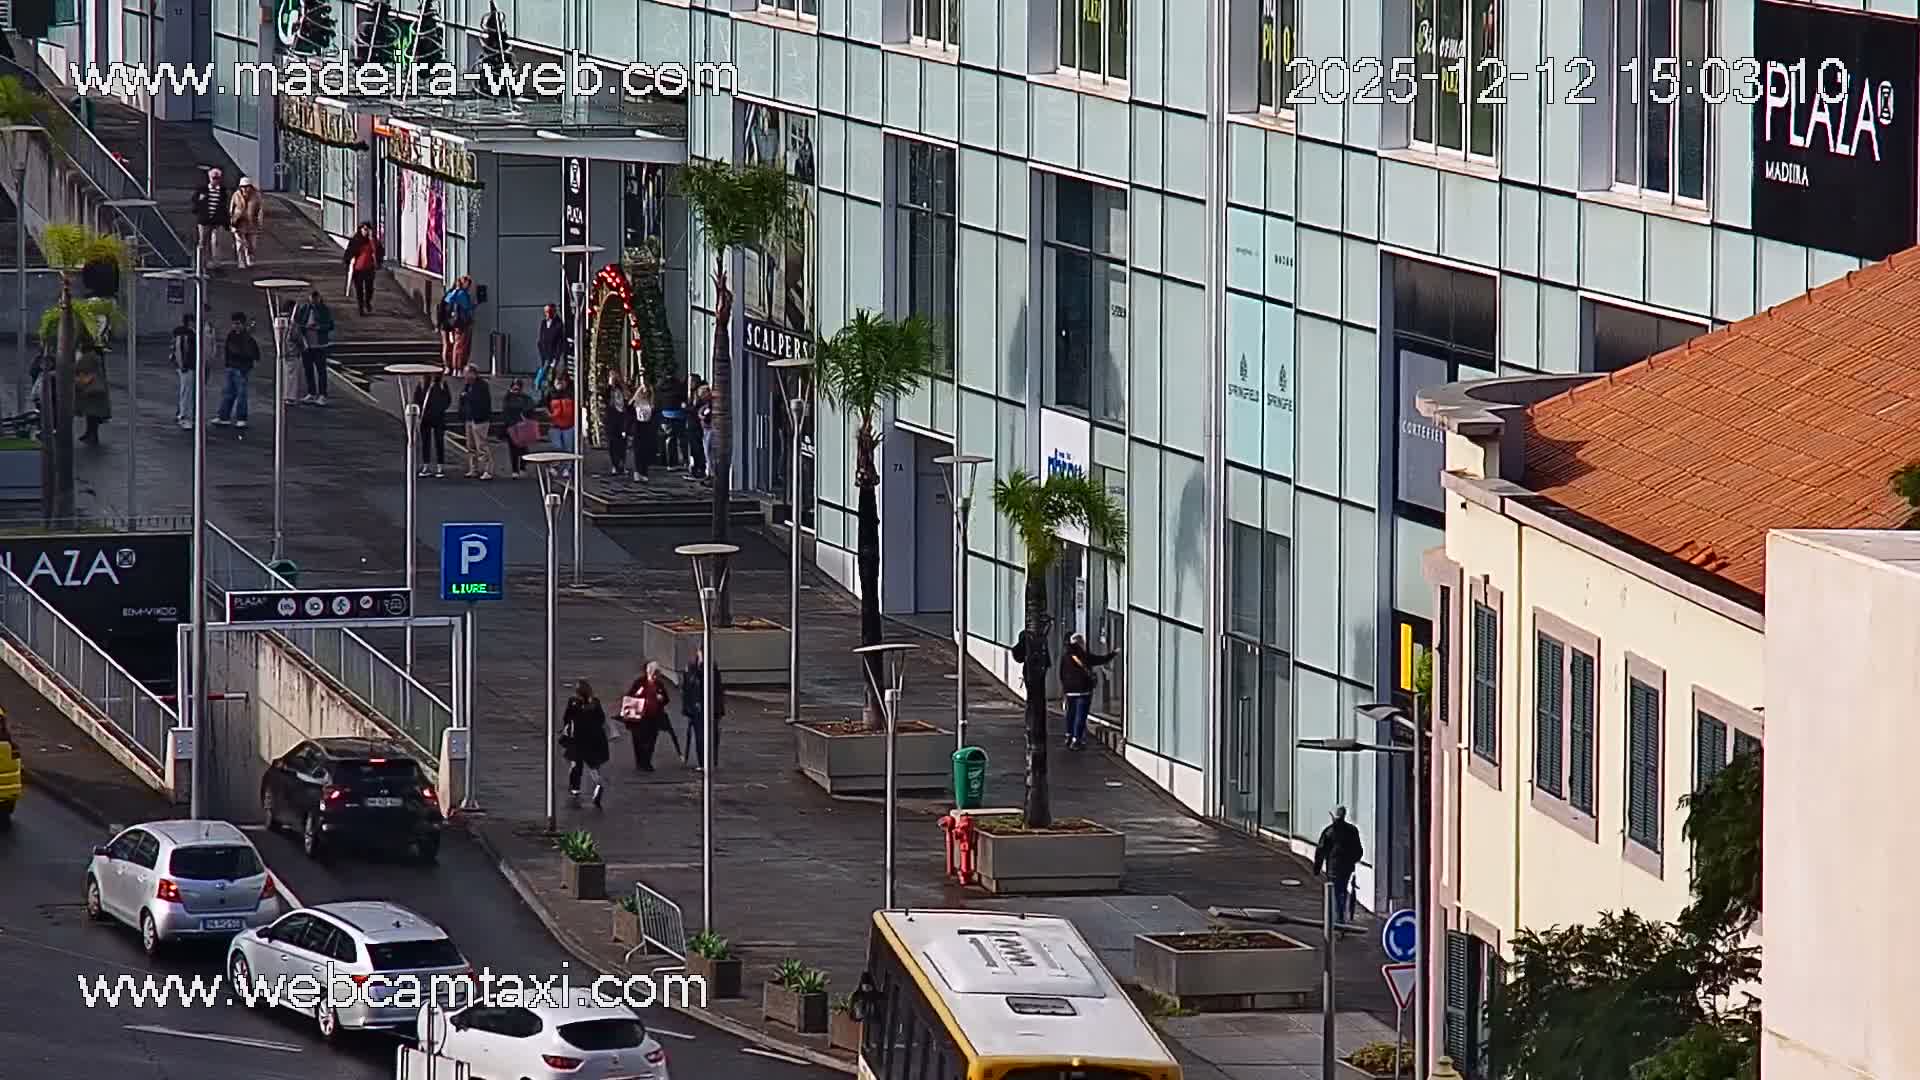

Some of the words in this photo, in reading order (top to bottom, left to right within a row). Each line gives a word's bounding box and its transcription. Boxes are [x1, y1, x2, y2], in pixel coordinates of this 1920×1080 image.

[746, 322, 809, 361] SCALPERS
[460, 540, 488, 575] P
[452, 583, 488, 594] LIVRE
